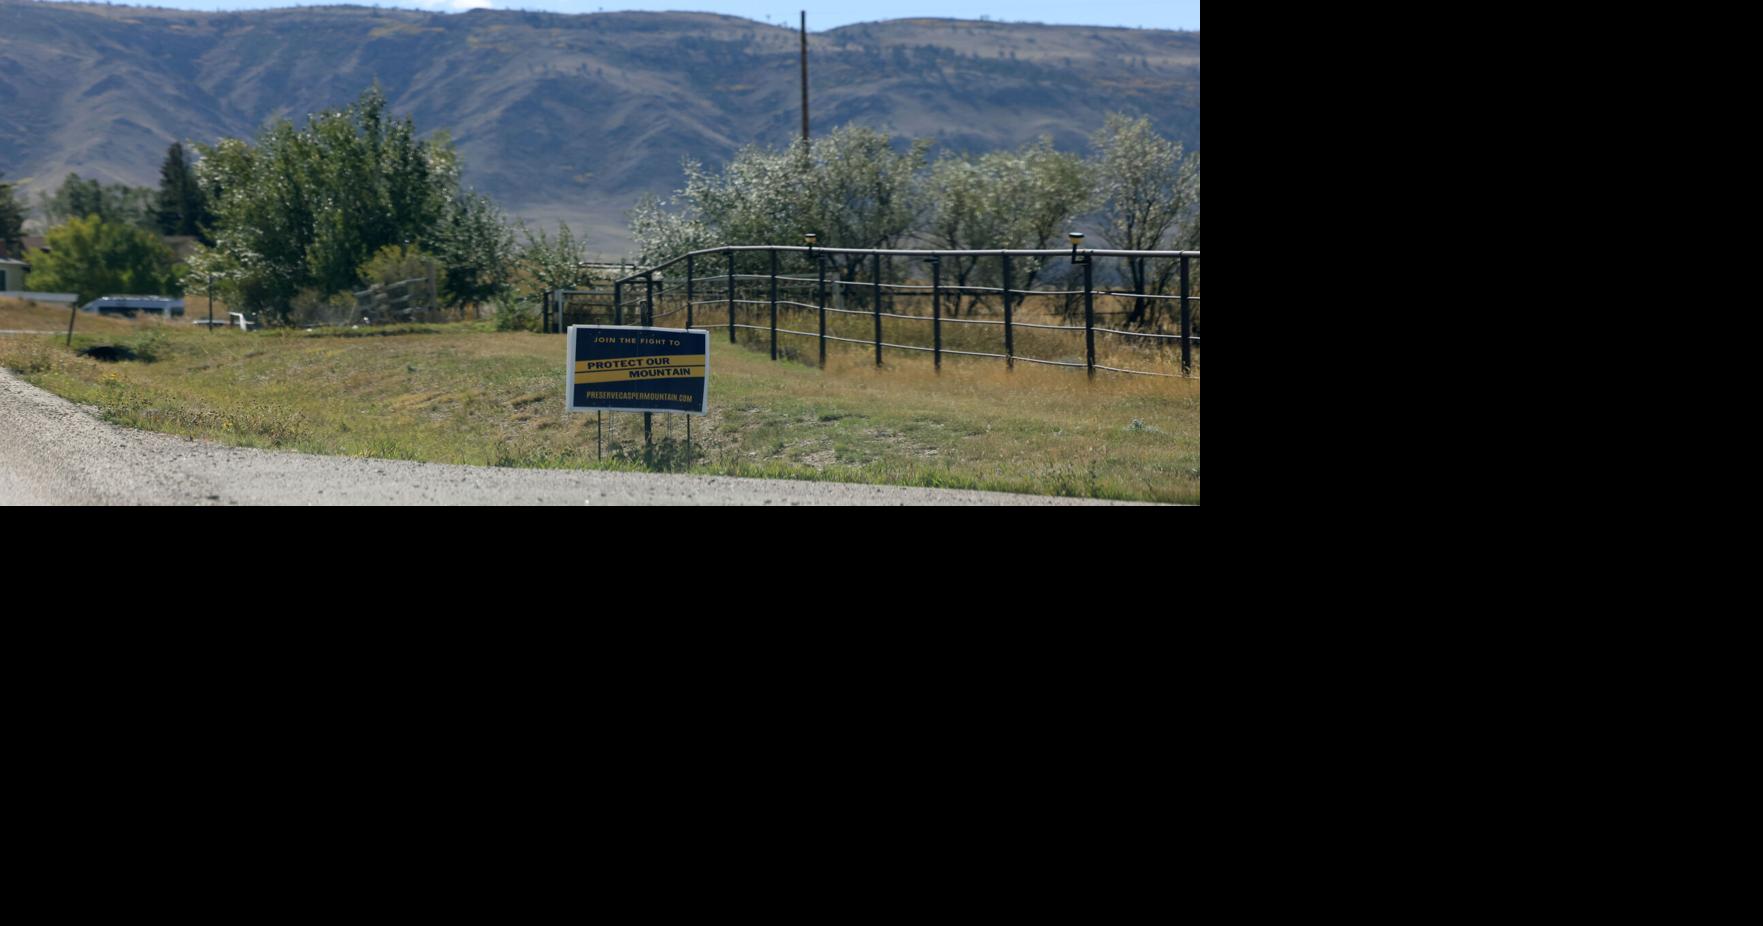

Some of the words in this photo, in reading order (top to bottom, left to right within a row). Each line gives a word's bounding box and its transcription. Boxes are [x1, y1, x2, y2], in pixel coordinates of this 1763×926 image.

[587, 359, 643, 369] PROTECT
[646, 357, 670, 365] OUR
[629, 368, 691, 378] MOUNTAIN
[586, 391, 693, 402] PRESERVECASPERMOUNTAIN.COM
